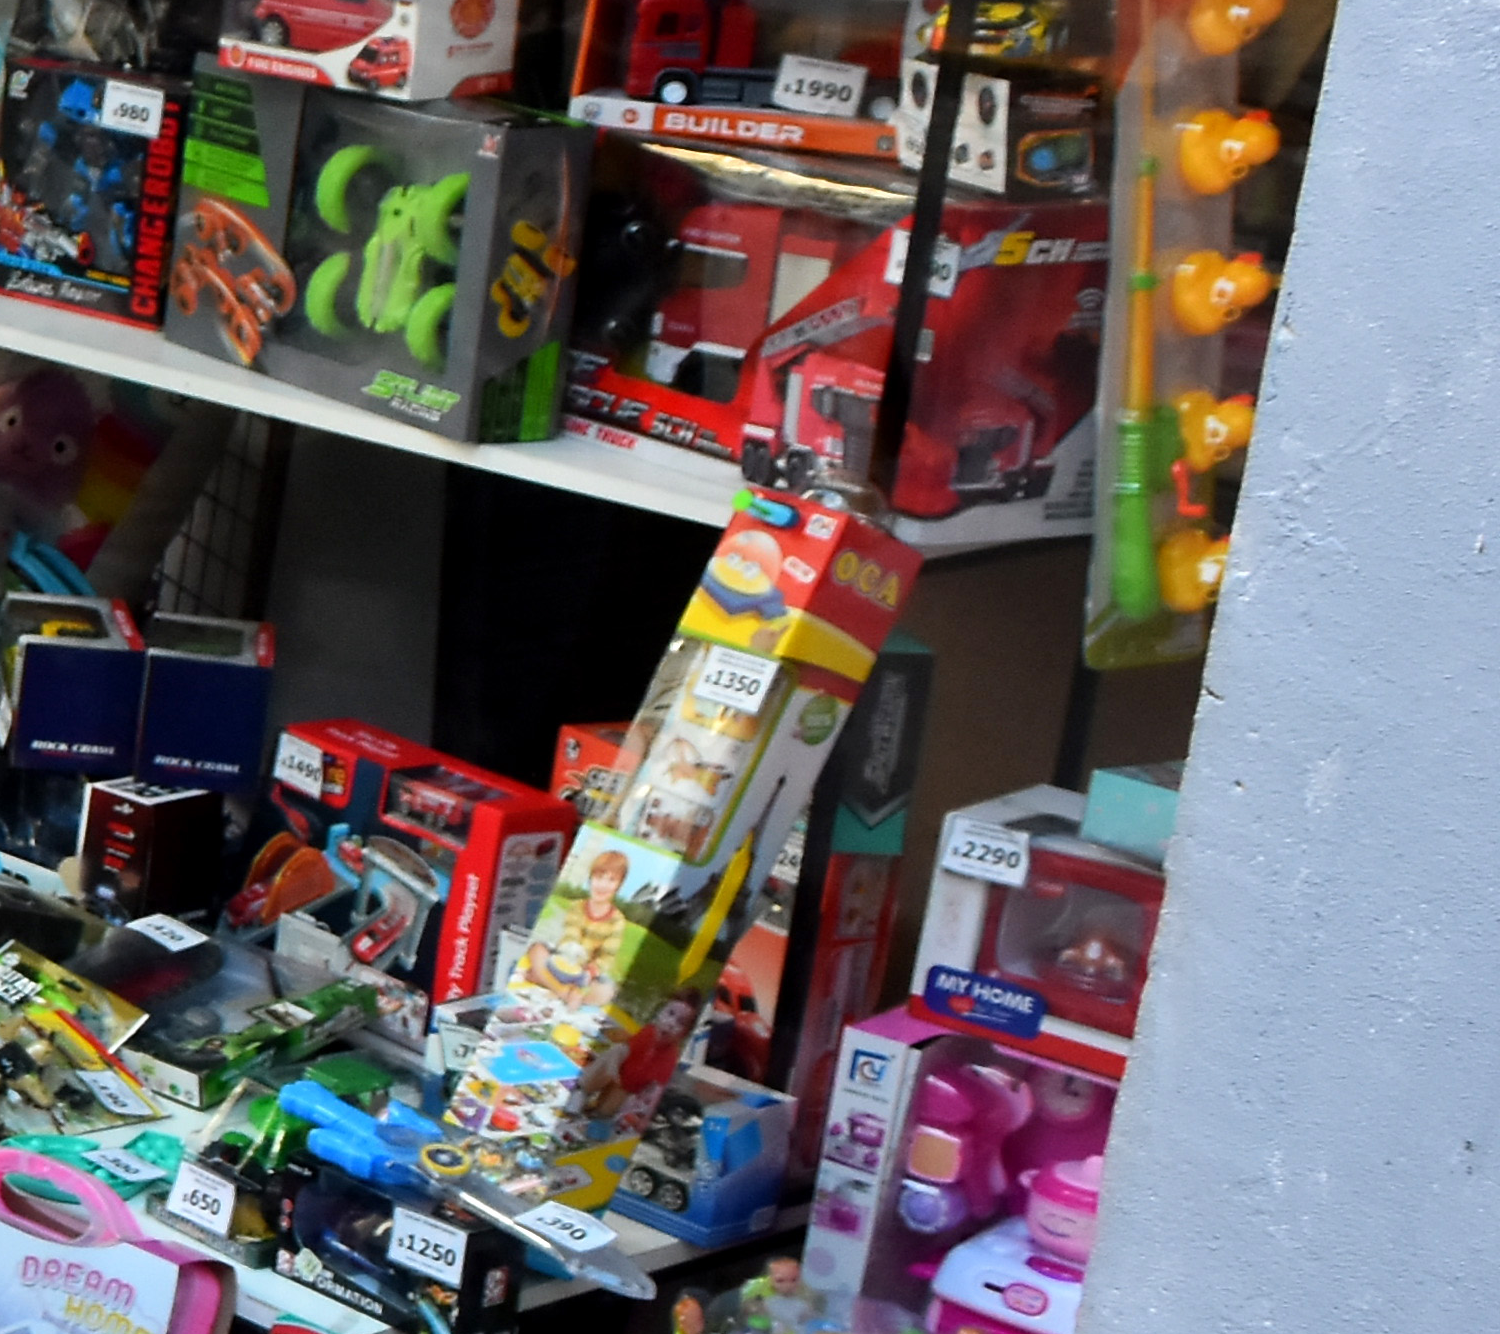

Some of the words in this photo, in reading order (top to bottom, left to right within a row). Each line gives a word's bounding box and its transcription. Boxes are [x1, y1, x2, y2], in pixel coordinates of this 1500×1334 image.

[783, 78, 853, 103] $1990
[113, 103, 150, 122] $980
[663, 111, 805, 143] BUILDER
[832, 550, 901, 610] OCA
[705, 669, 761, 696] $1350
[952, 840, 1021, 869] $2290
[934, 964, 970, 993] MY
[975, 978, 1036, 1015] HOME
[181, 1191, 222, 1217] $650
[536, 1215, 587, 1241] $390
[397, 1233, 459, 1269] $1250
[20, 1255, 136, 1317] DREAM
